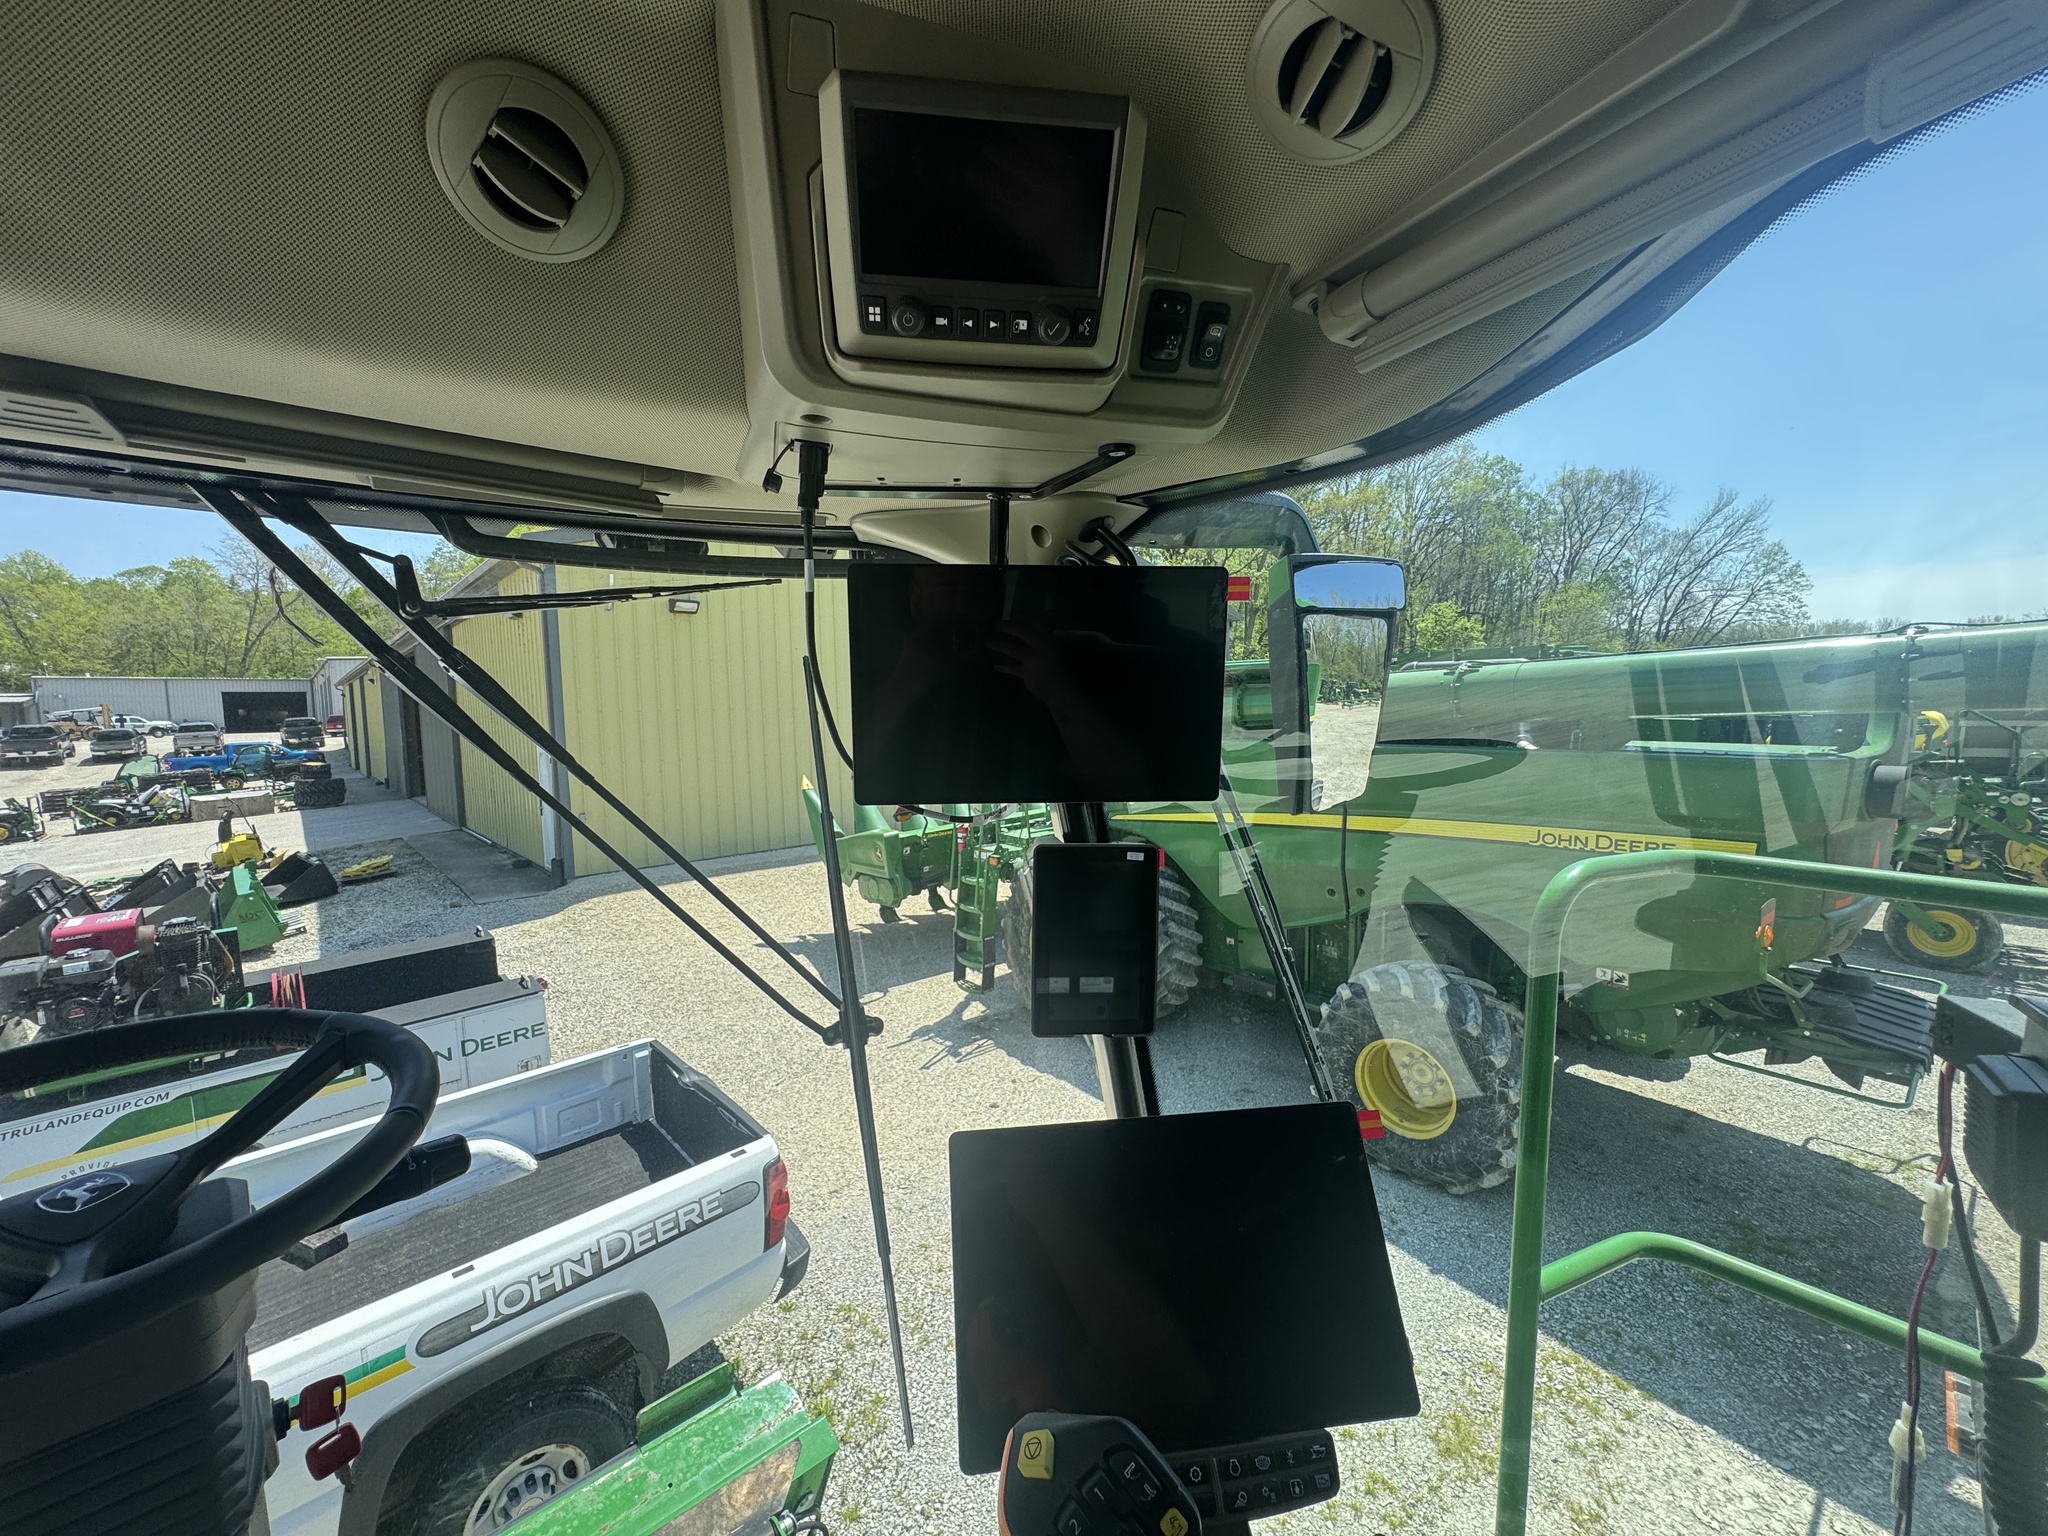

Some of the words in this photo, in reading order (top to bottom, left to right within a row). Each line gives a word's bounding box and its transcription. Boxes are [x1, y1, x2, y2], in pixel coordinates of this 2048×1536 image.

[1529, 829, 1589, 850] JOHN
[460, 1021, 546, 1057] DEERE
[0, 1091, 170, 1142] TRULANDEQUIP.COM
[61, 1161, 118, 1181] PROVID
[470, 1251, 595, 1332] JOHN
[600, 1190, 724, 1269] DEERE
[1093, 1487, 1105, 1501] 1
[1068, 1519, 1082, 1536] 2
